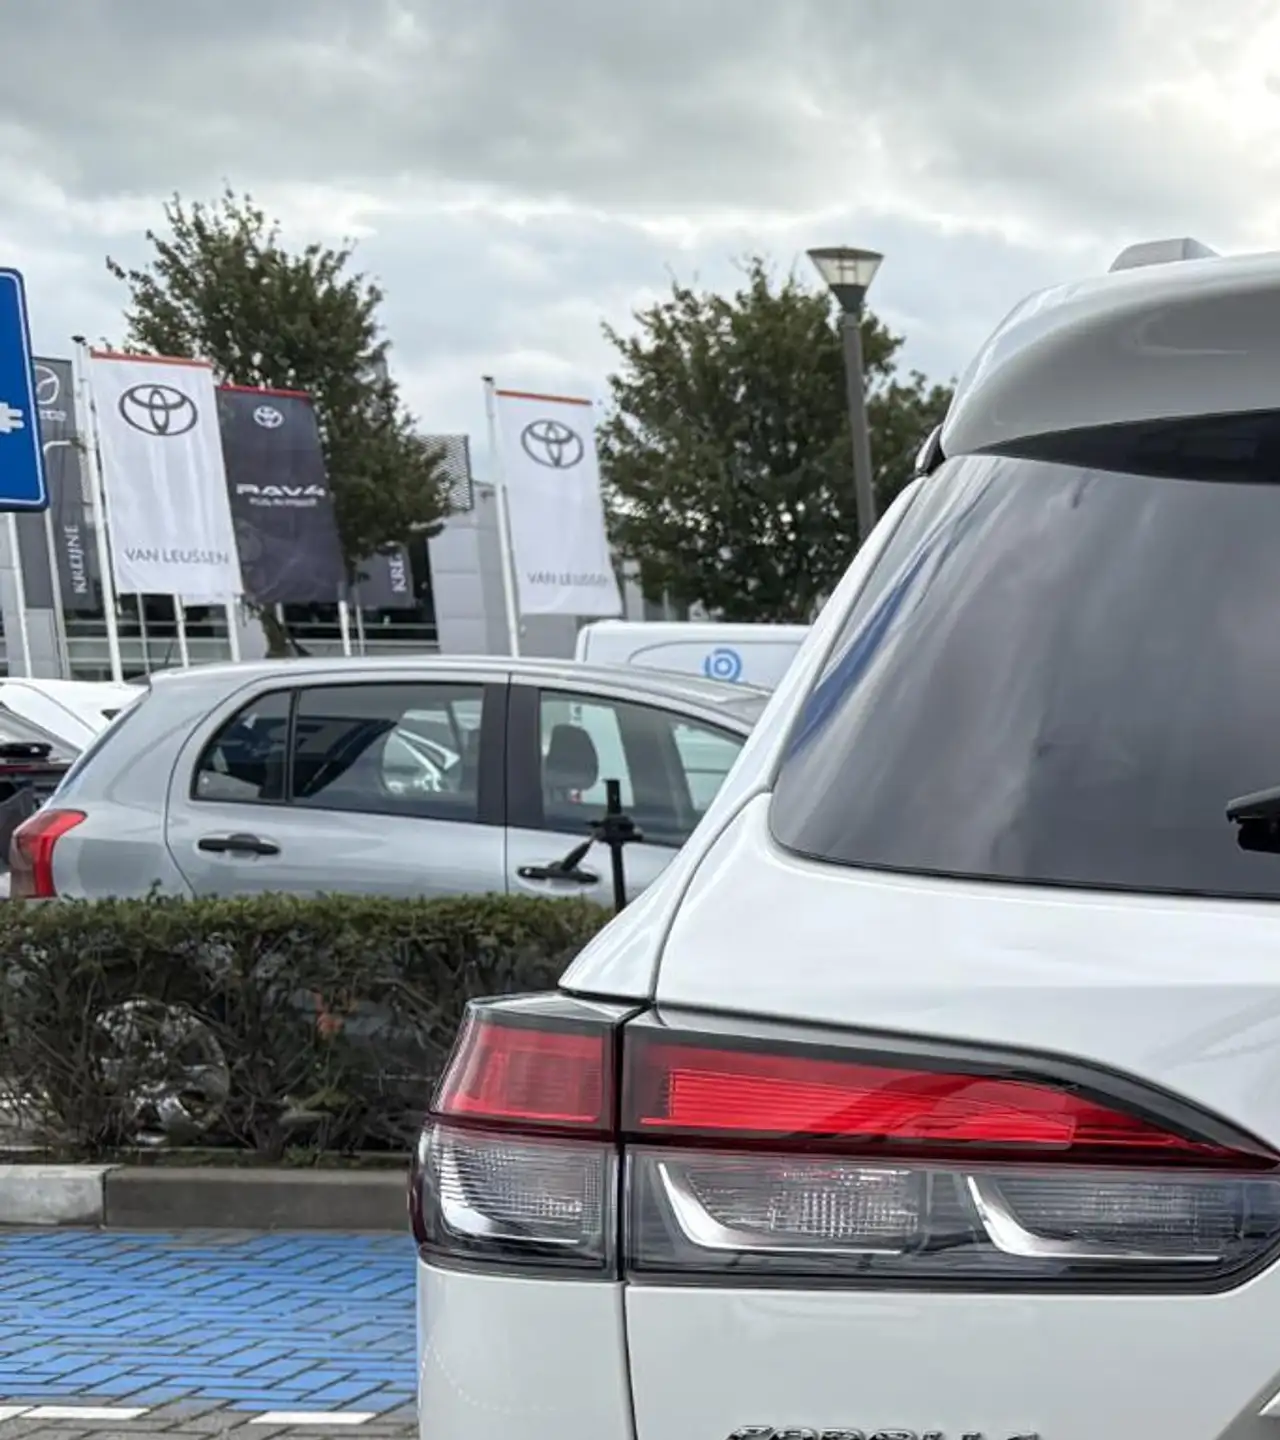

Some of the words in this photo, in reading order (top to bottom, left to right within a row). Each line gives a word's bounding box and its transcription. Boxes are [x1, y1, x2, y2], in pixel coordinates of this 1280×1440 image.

[236, 483, 325, 496] RAV4
[124, 549, 159, 562] VAN
[526, 570, 557, 585] VAN
